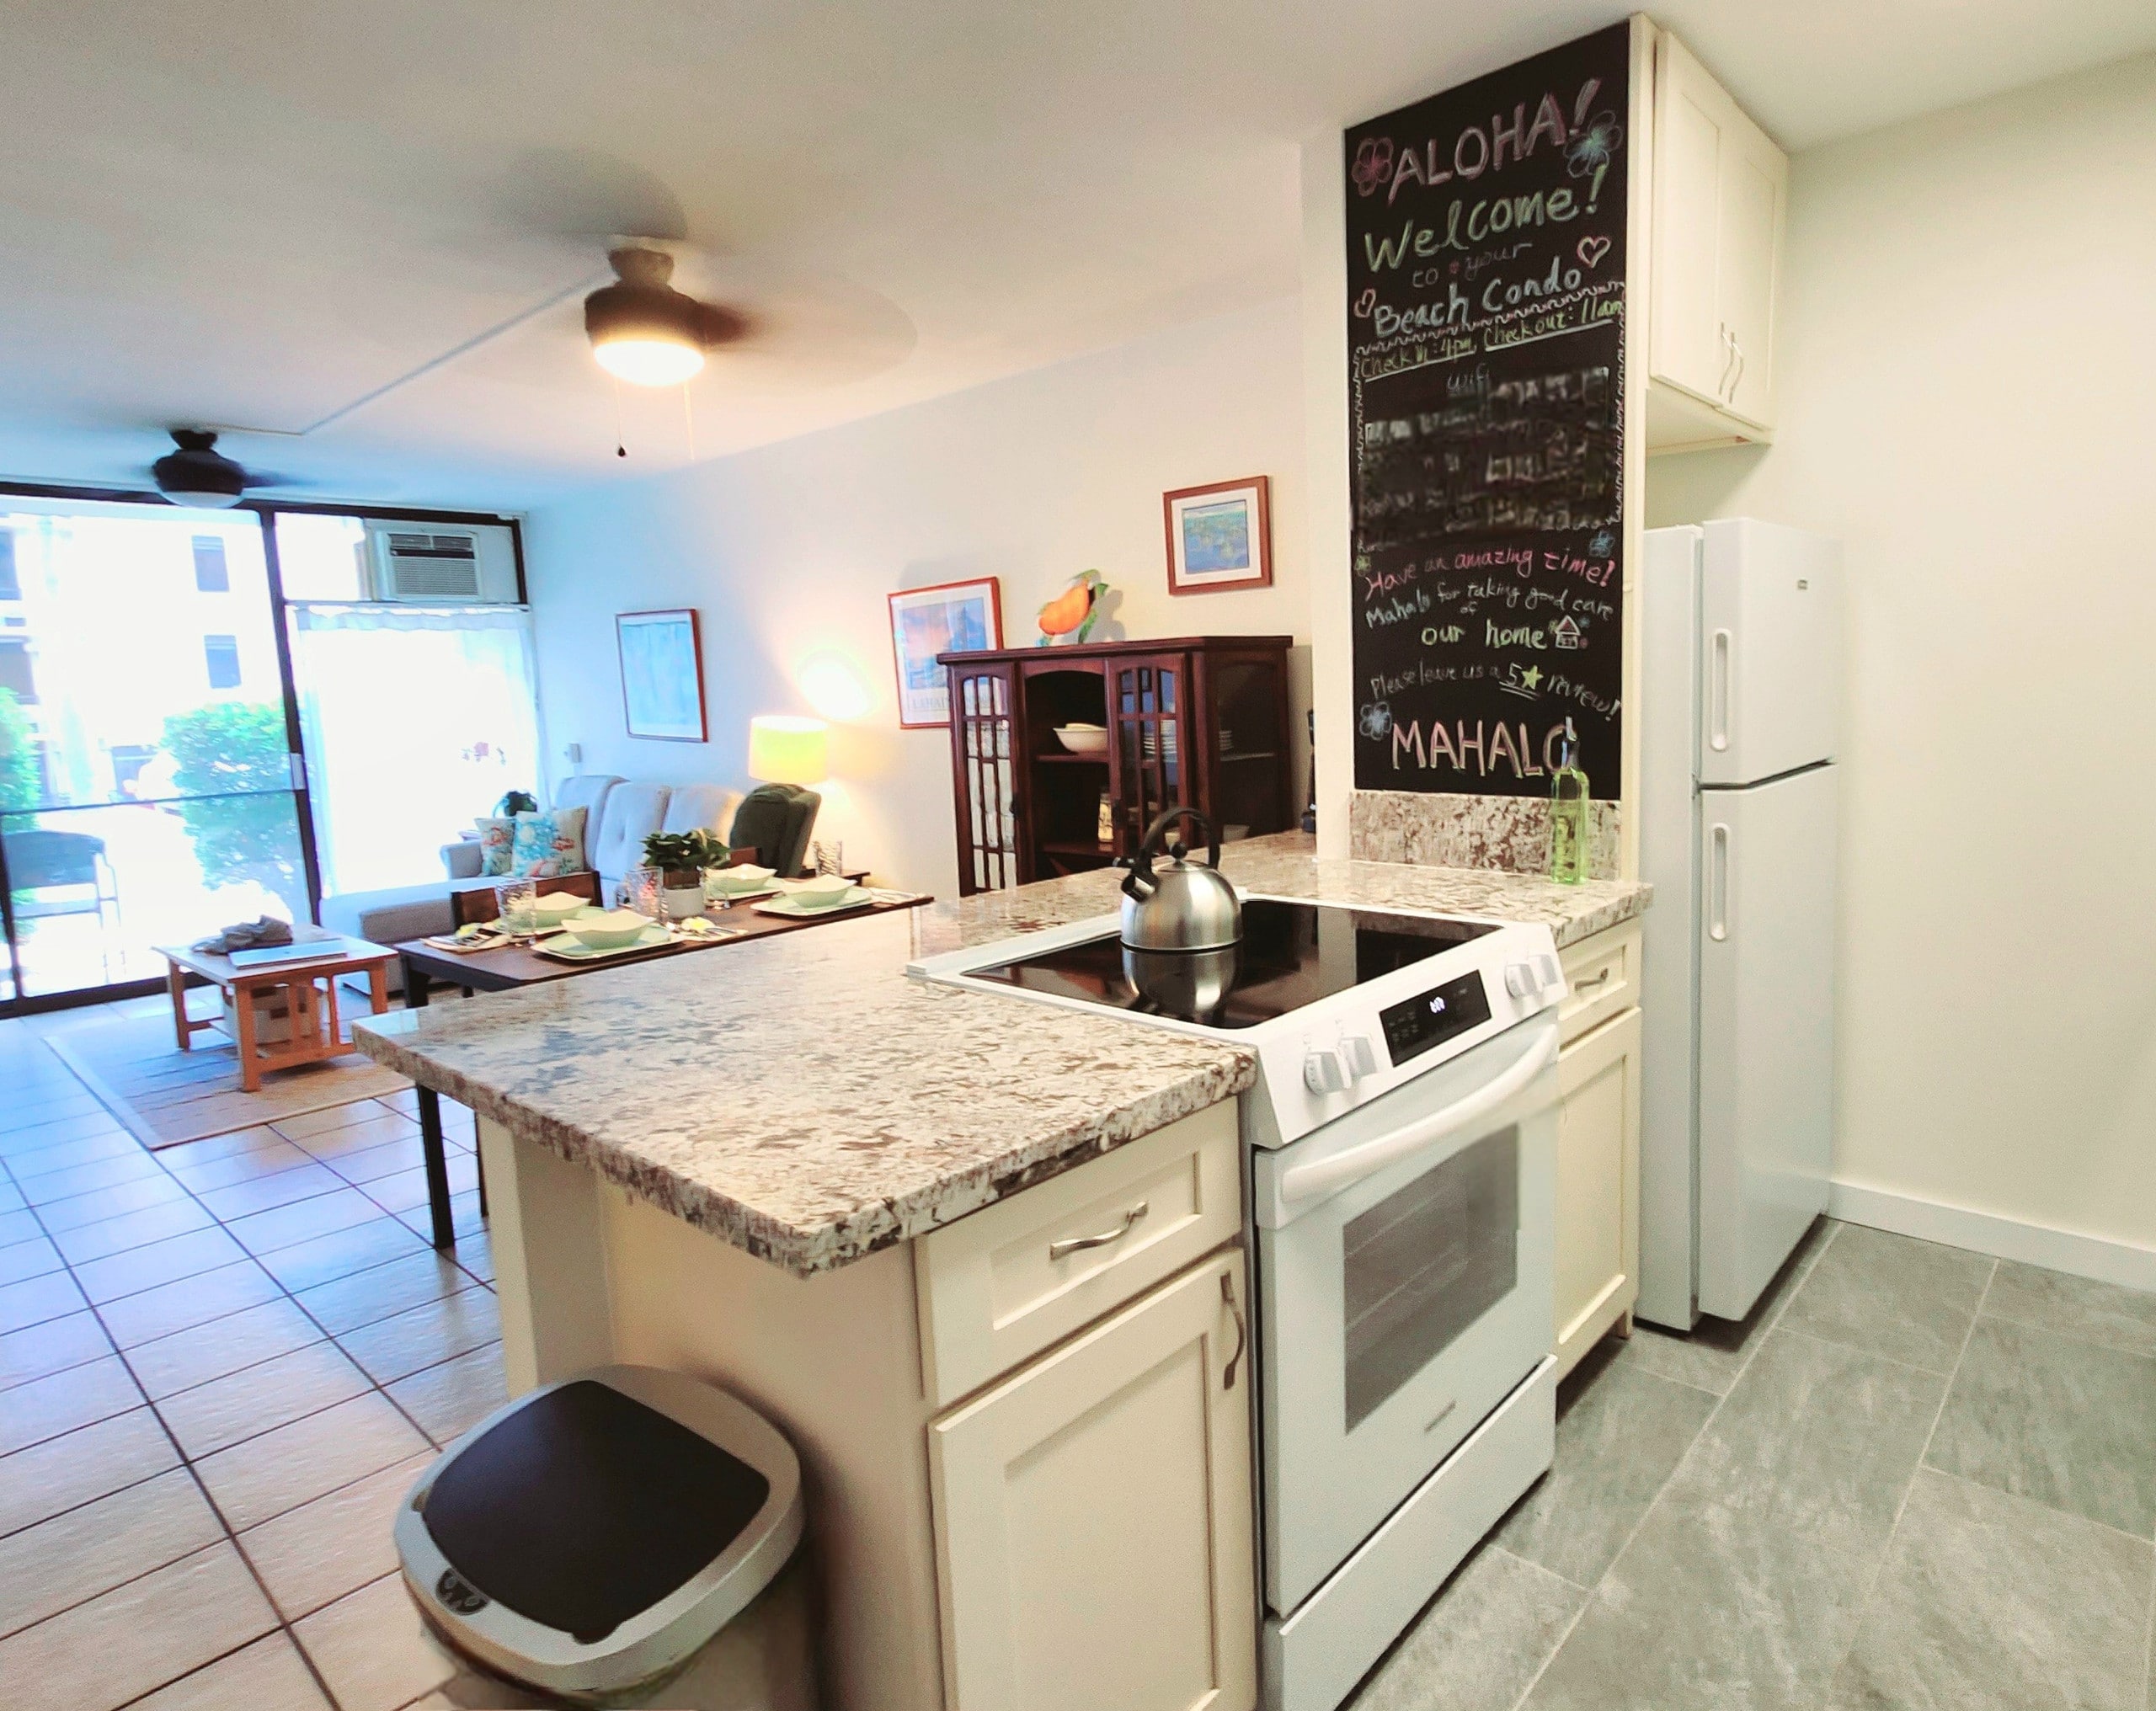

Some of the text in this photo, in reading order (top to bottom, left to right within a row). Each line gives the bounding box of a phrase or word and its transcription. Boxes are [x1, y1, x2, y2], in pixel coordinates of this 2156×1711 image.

[1388, 78, 1601, 204] ALOHA!
[1364, 164, 1606, 273] Welcome!
[1412, 242, 1533, 288] to your
[1374, 255, 1581, 337] Beach Condo
[1365, 546, 1616, 601] Have an amazing time!
[1366, 577, 1614, 629] Mahalo for taking good care
[1460, 600, 1478, 616] of
[1422, 618, 1547, 649] our home
[1369, 670, 1415, 699] Please
[1419, 658, 1457, 685] leave
[1463, 665, 1484, 680] us
[1490, 664, 1501, 680] a
